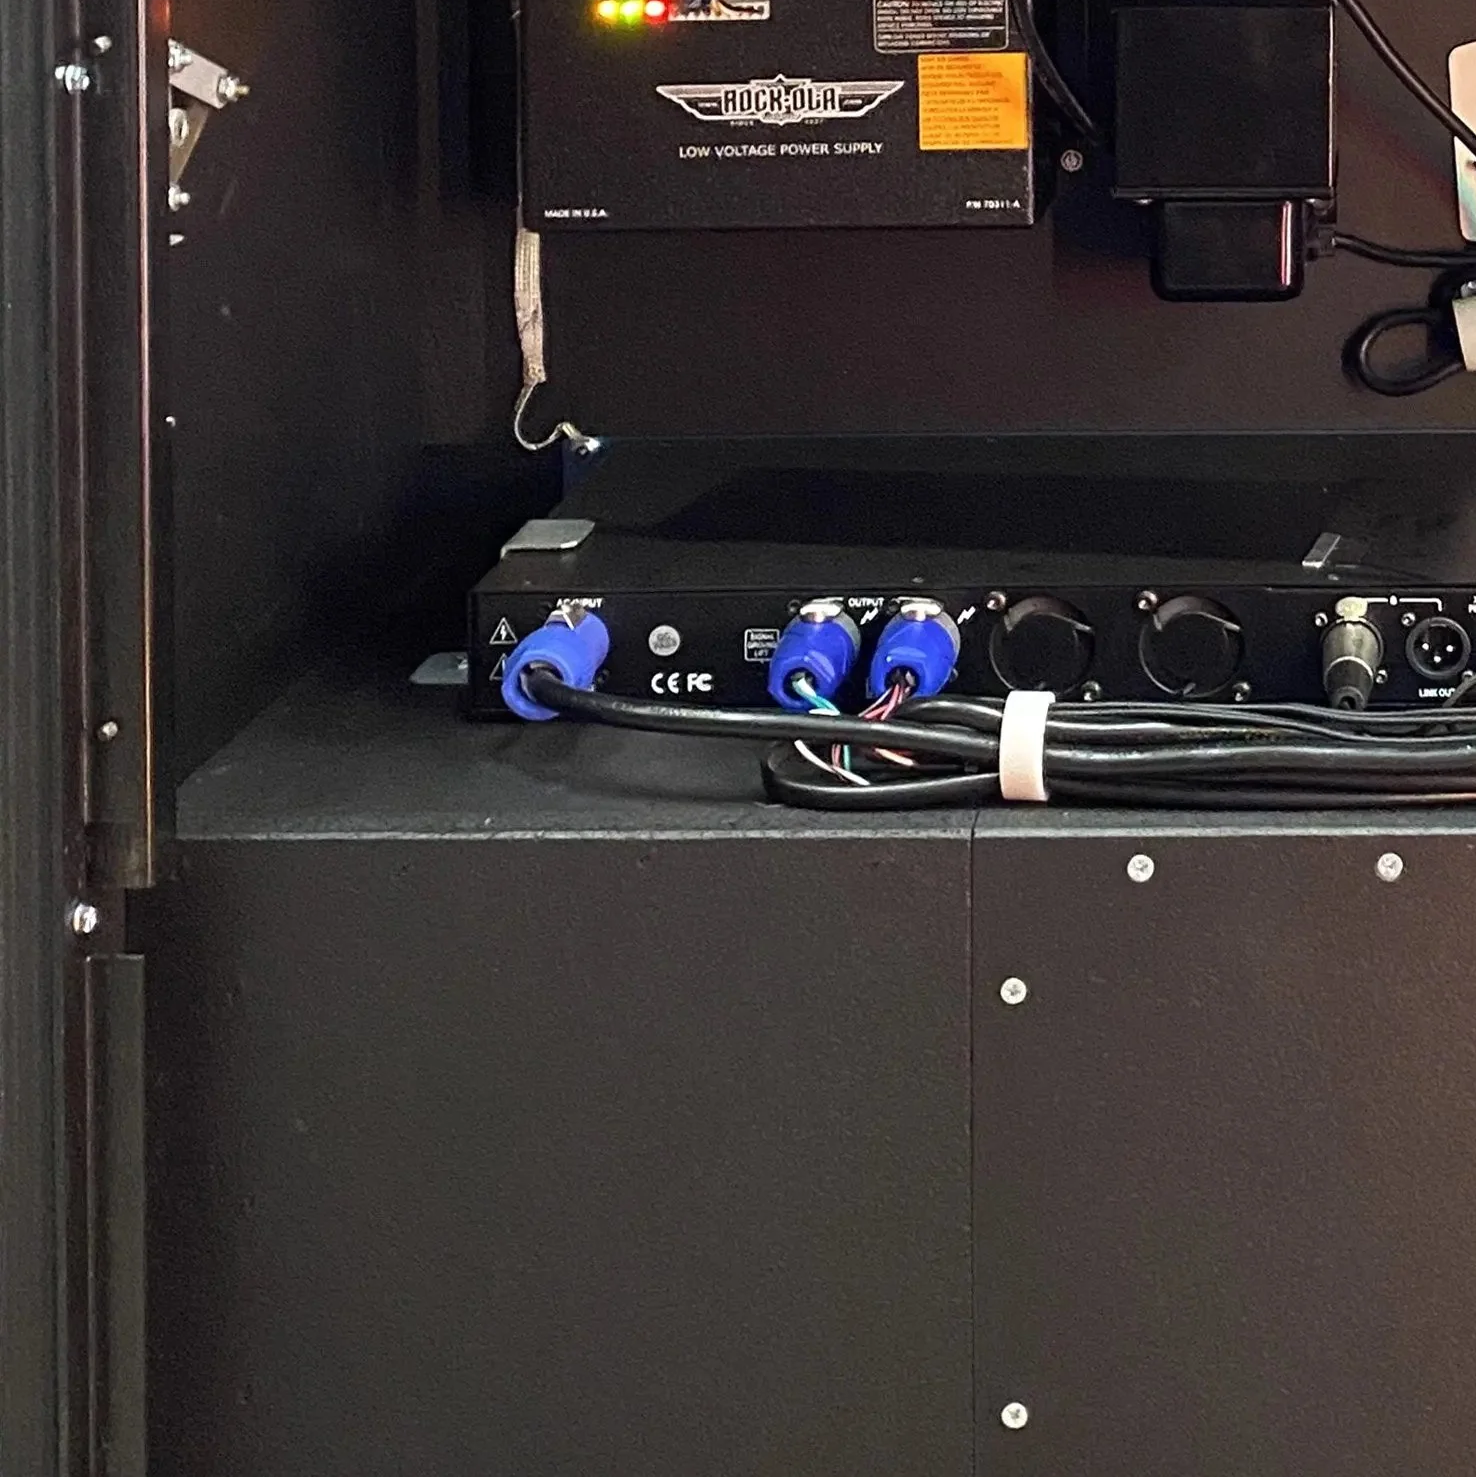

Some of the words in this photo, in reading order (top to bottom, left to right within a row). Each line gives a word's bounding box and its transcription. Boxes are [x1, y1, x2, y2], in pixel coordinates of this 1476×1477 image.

[679, 145, 711, 159] LOW
[713, 144, 776, 159] VOLTAGE
[780, 143, 830, 156] POWER
[834, 141, 884, 155] SUPPLY
[848, 597, 885, 607] OUTPUT
